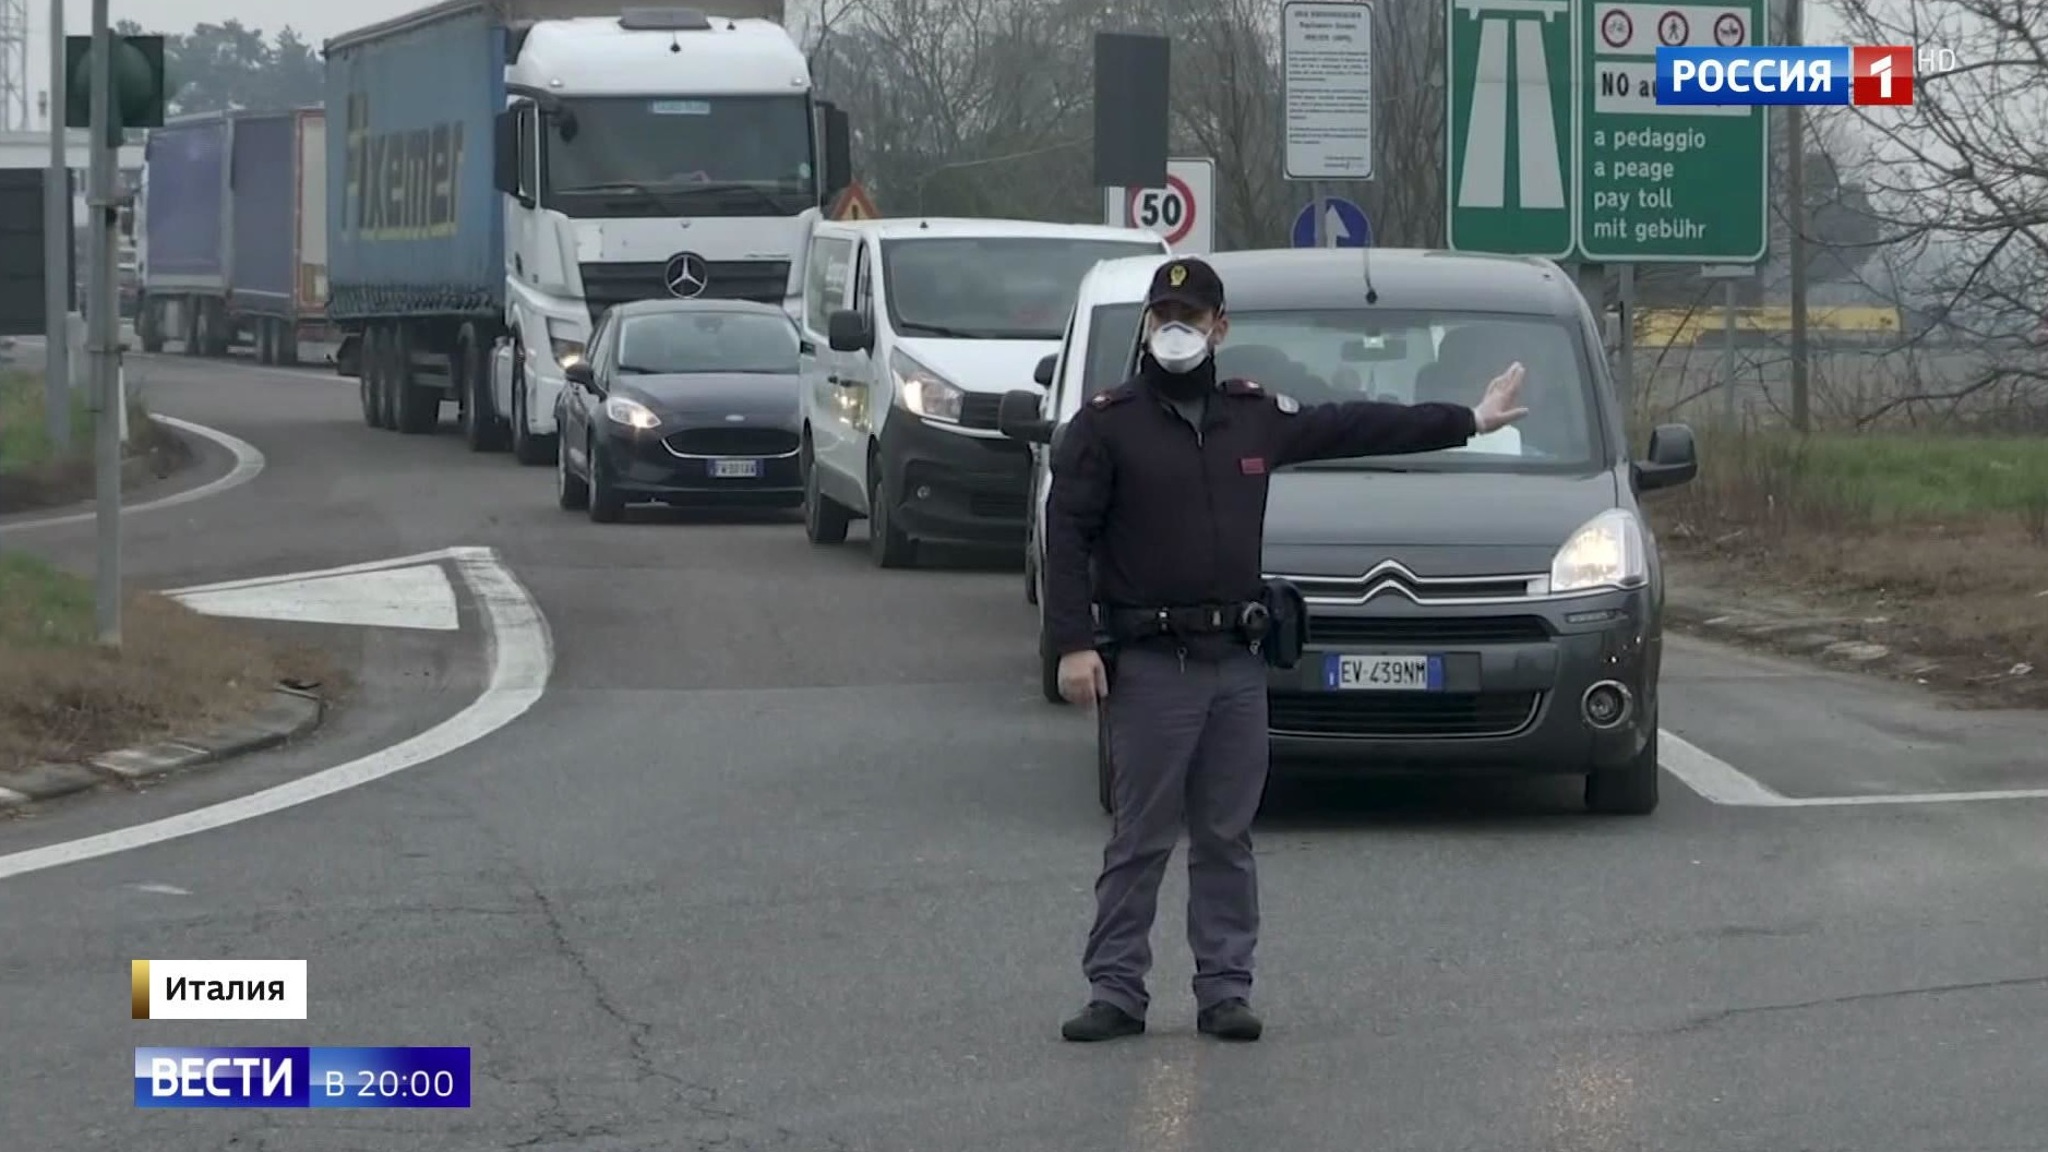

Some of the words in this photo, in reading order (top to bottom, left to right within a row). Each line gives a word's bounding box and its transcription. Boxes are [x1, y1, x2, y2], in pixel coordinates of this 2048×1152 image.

[1602, 71, 1629, 97] NO
[1594, 131, 1606, 147] a
[1614, 128, 1706, 152] pedaggio
[1594, 162, 1606, 177] a
[1614, 161, 1675, 182] peage
[1141, 193, 1182, 228] 50
[1594, 194, 1630, 211] pay
[1638, 191, 1673, 208] toll
[1594, 221, 1627, 239] mit
[1635, 220, 1706, 242] gebühr
